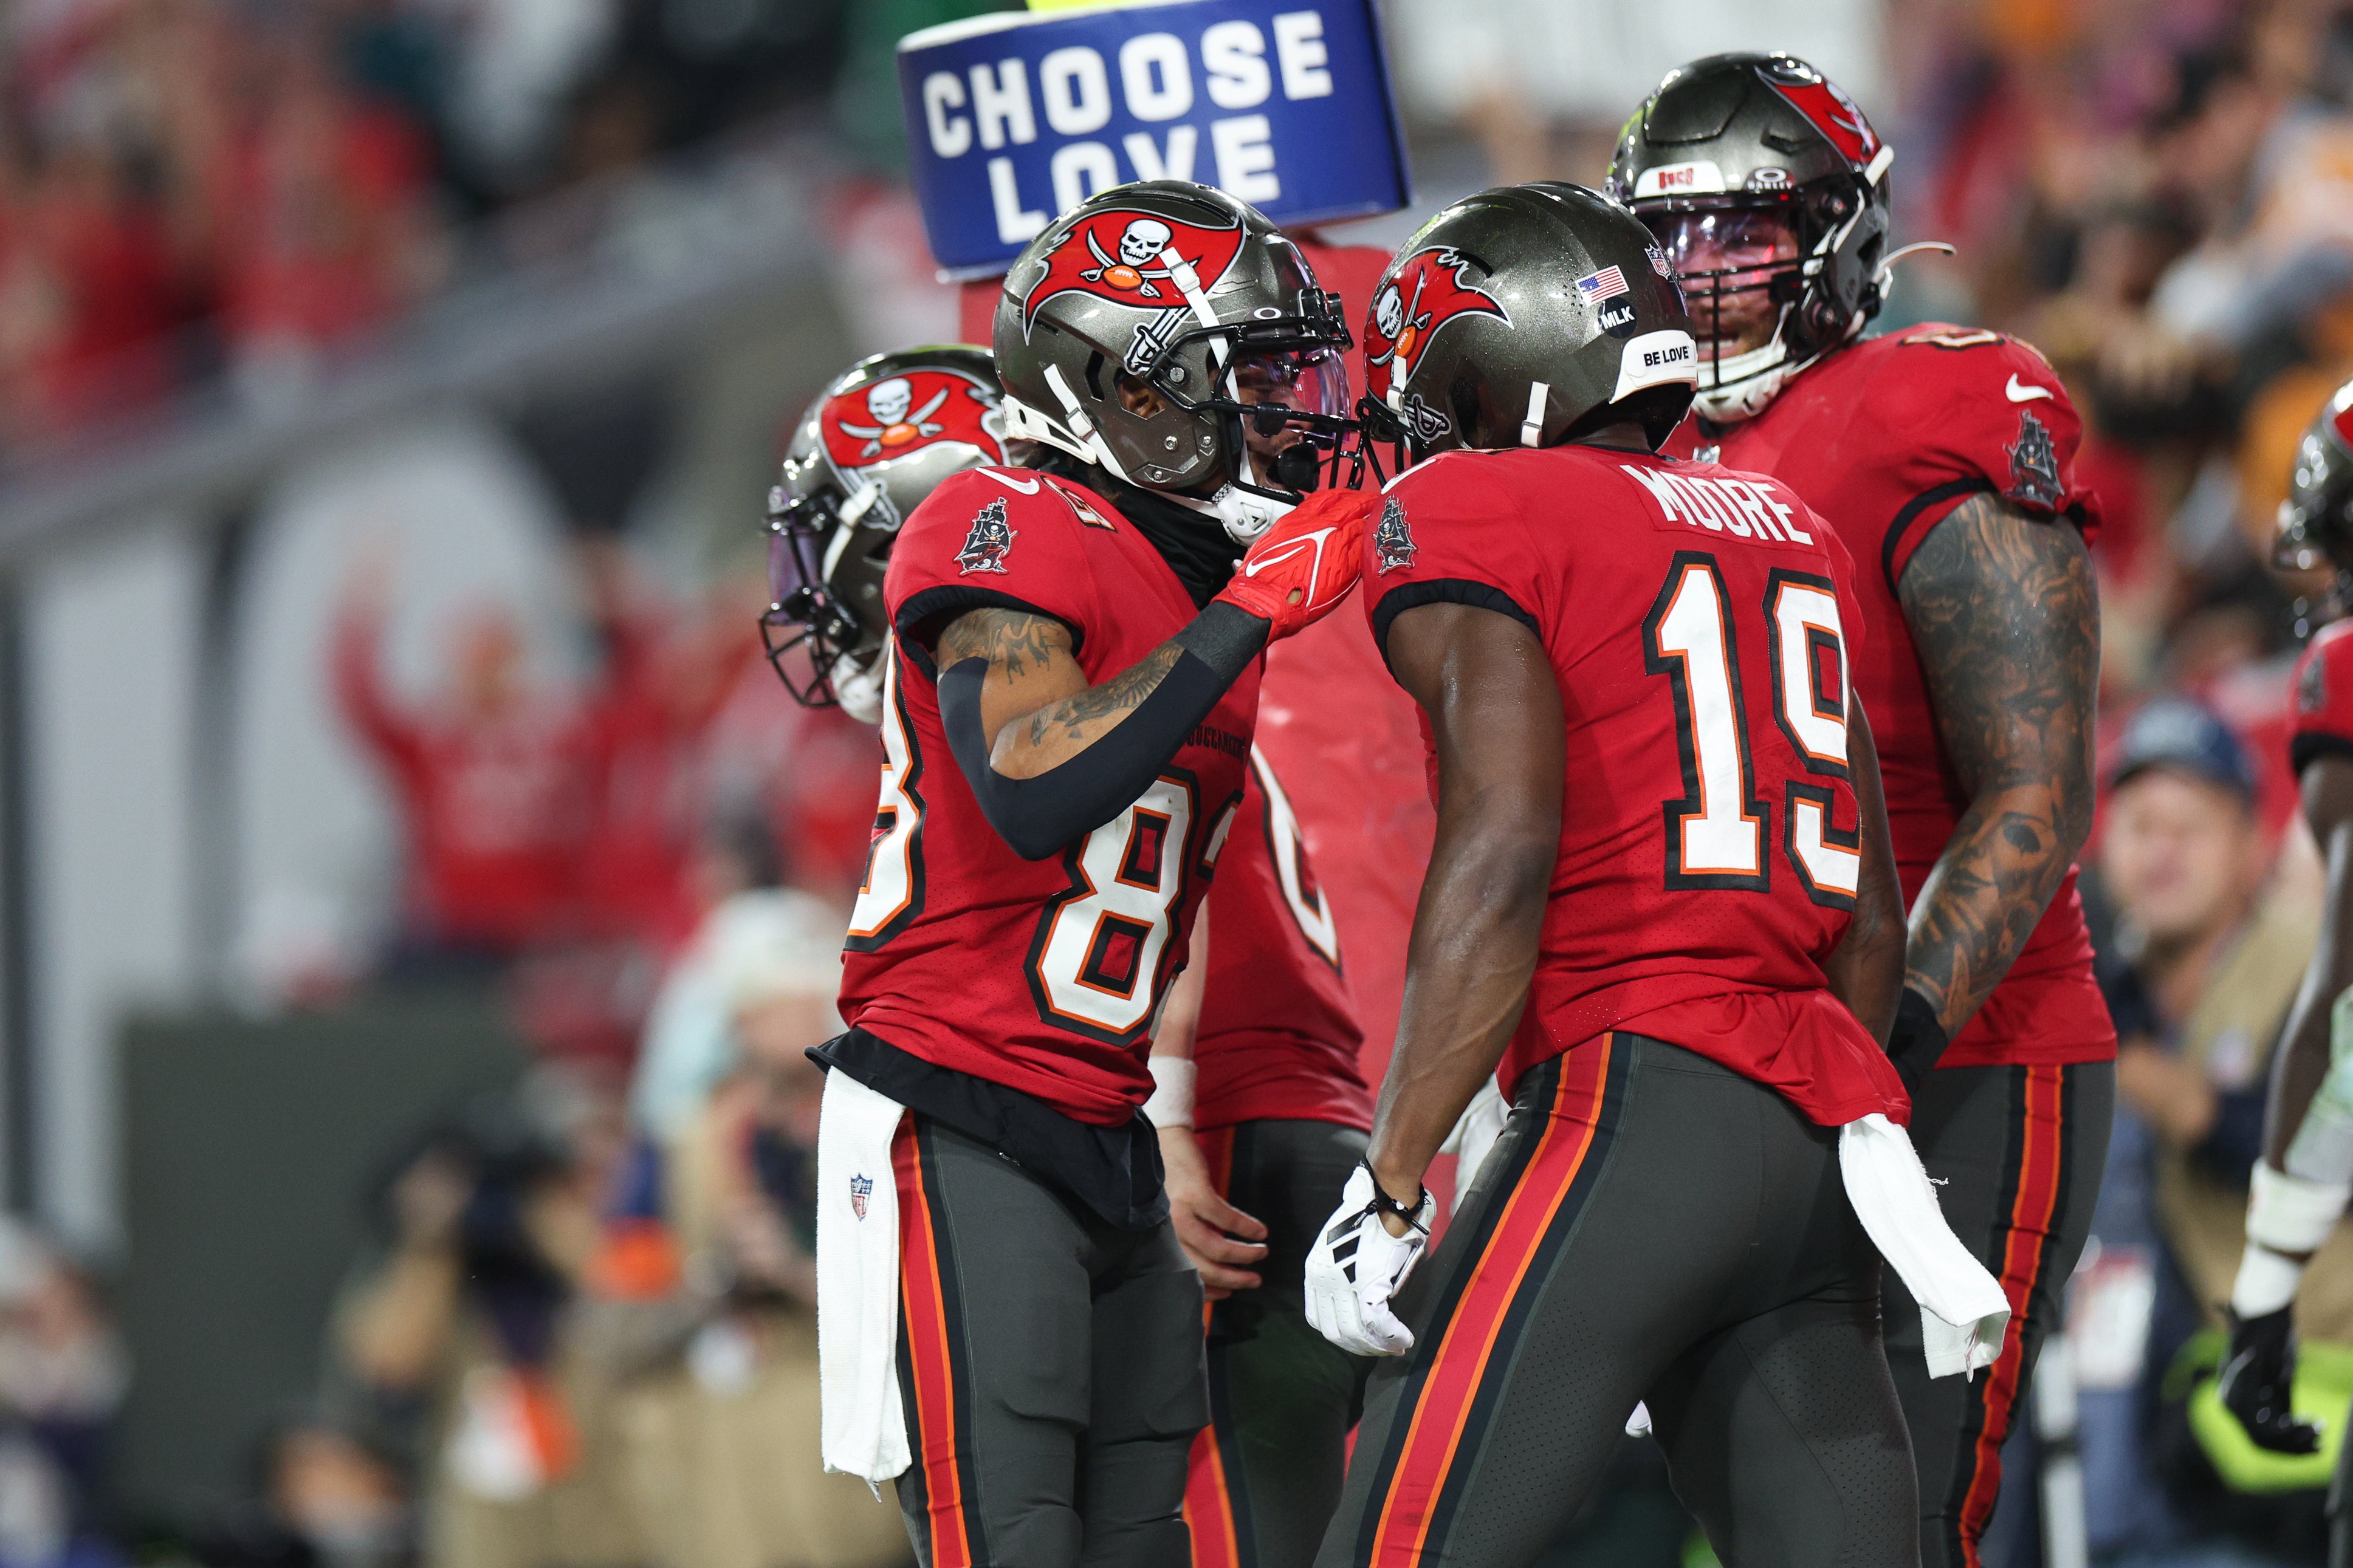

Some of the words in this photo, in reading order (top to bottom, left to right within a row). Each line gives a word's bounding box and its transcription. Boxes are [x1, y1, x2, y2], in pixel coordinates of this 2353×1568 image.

[922, 10, 1335, 159] CHOOSE
[987, 114, 1282, 244] LOVE
[1653, 258, 1669, 273] NFL
[1600, 306, 1635, 329] MLK
[1644, 351, 1661, 367] BE
[1620, 465, 1815, 546] MOORE
[1641, 550, 1863, 911] 19
